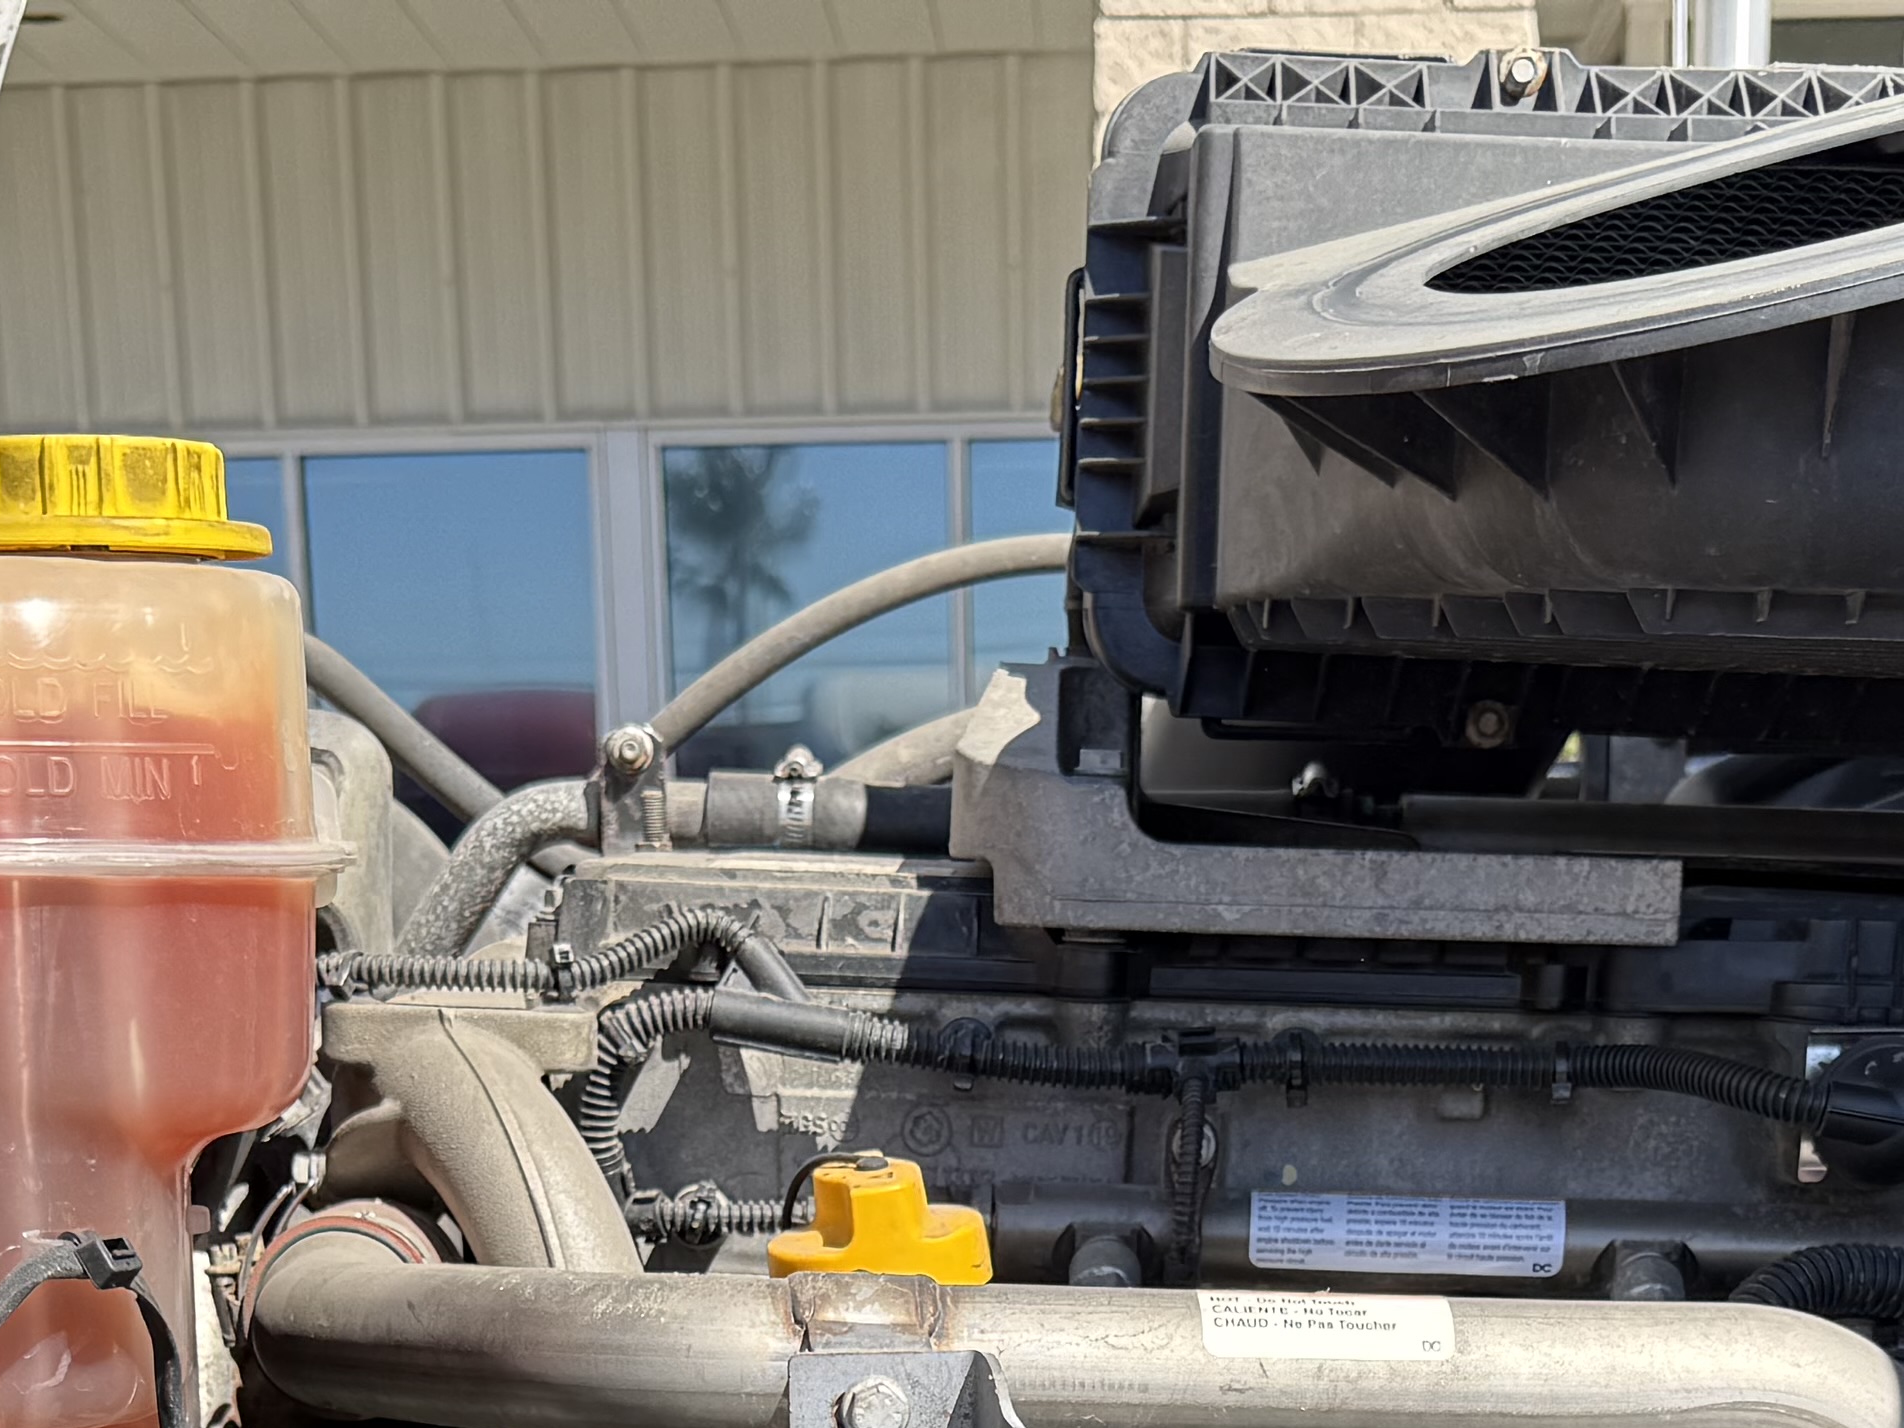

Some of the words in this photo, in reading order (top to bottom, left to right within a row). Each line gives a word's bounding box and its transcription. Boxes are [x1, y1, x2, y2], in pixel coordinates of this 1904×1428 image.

[101, 755, 172, 800] MIN
[1532, 1263, 1552, 1273] DC
[1213, 1317, 1268, 1328] CHAUD
